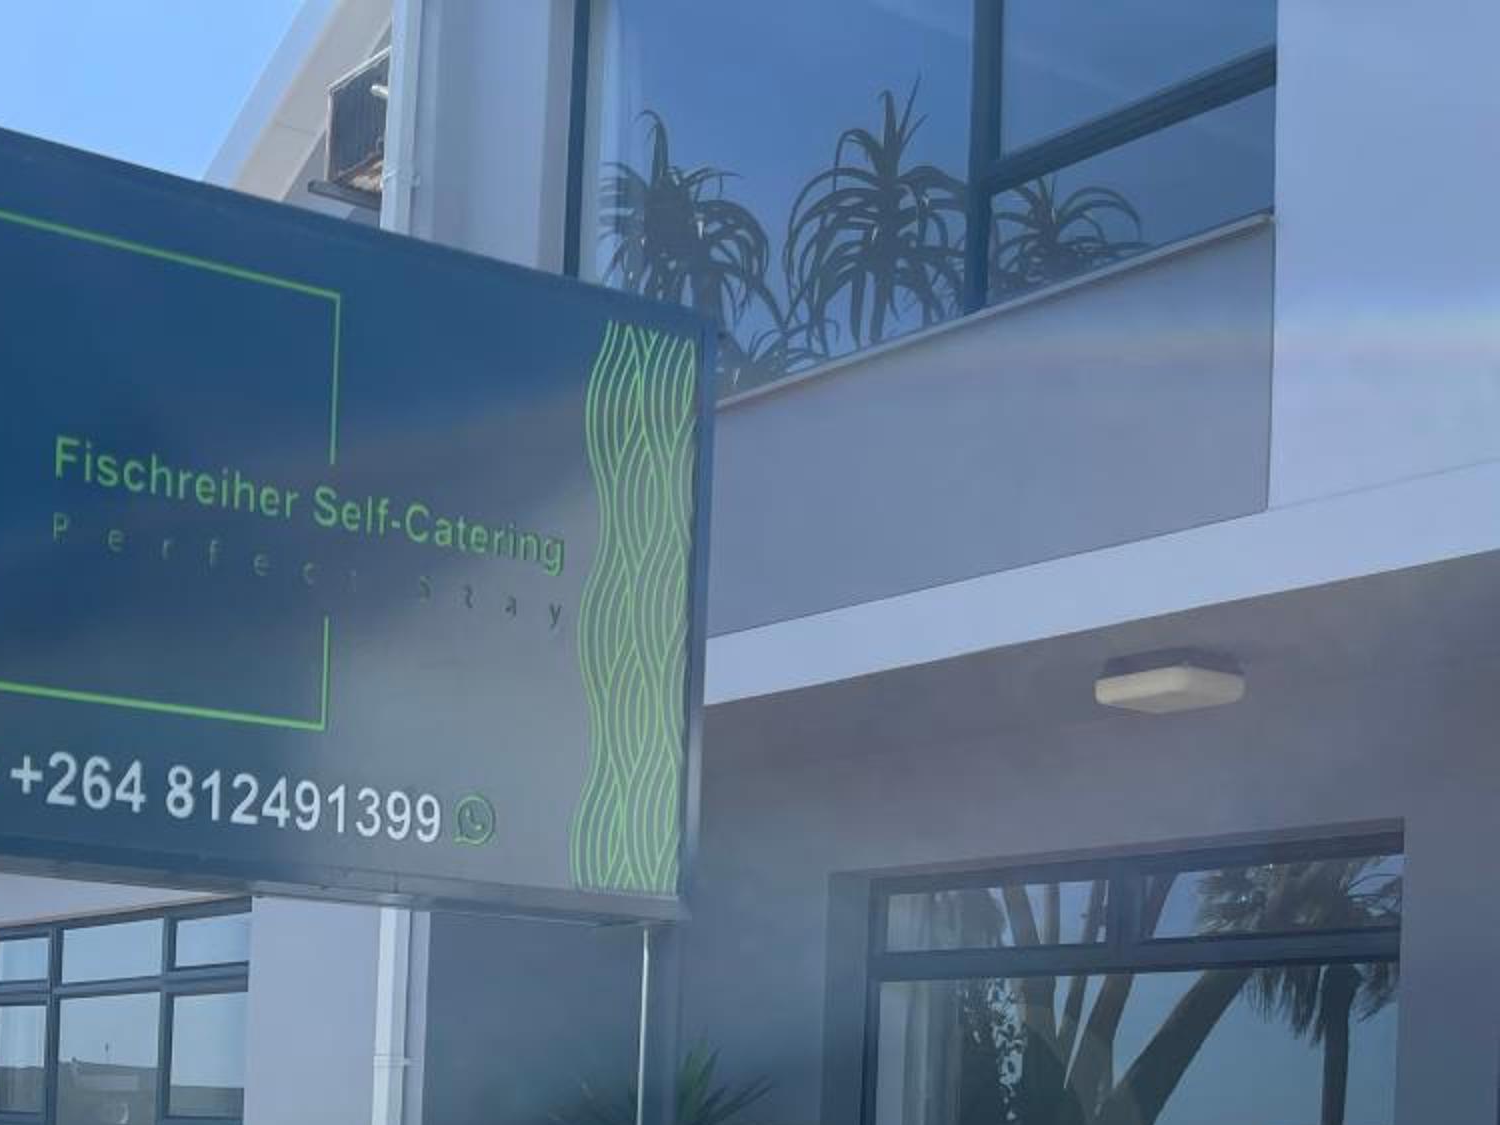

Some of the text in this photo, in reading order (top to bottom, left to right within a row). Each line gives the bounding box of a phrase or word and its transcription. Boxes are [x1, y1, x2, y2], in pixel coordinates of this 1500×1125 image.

[51, 512, 357, 592] Perfec
[53, 435, 566, 577] Fischreiher Self-Catering
[9, 751, 442, 843] +264 812491399
